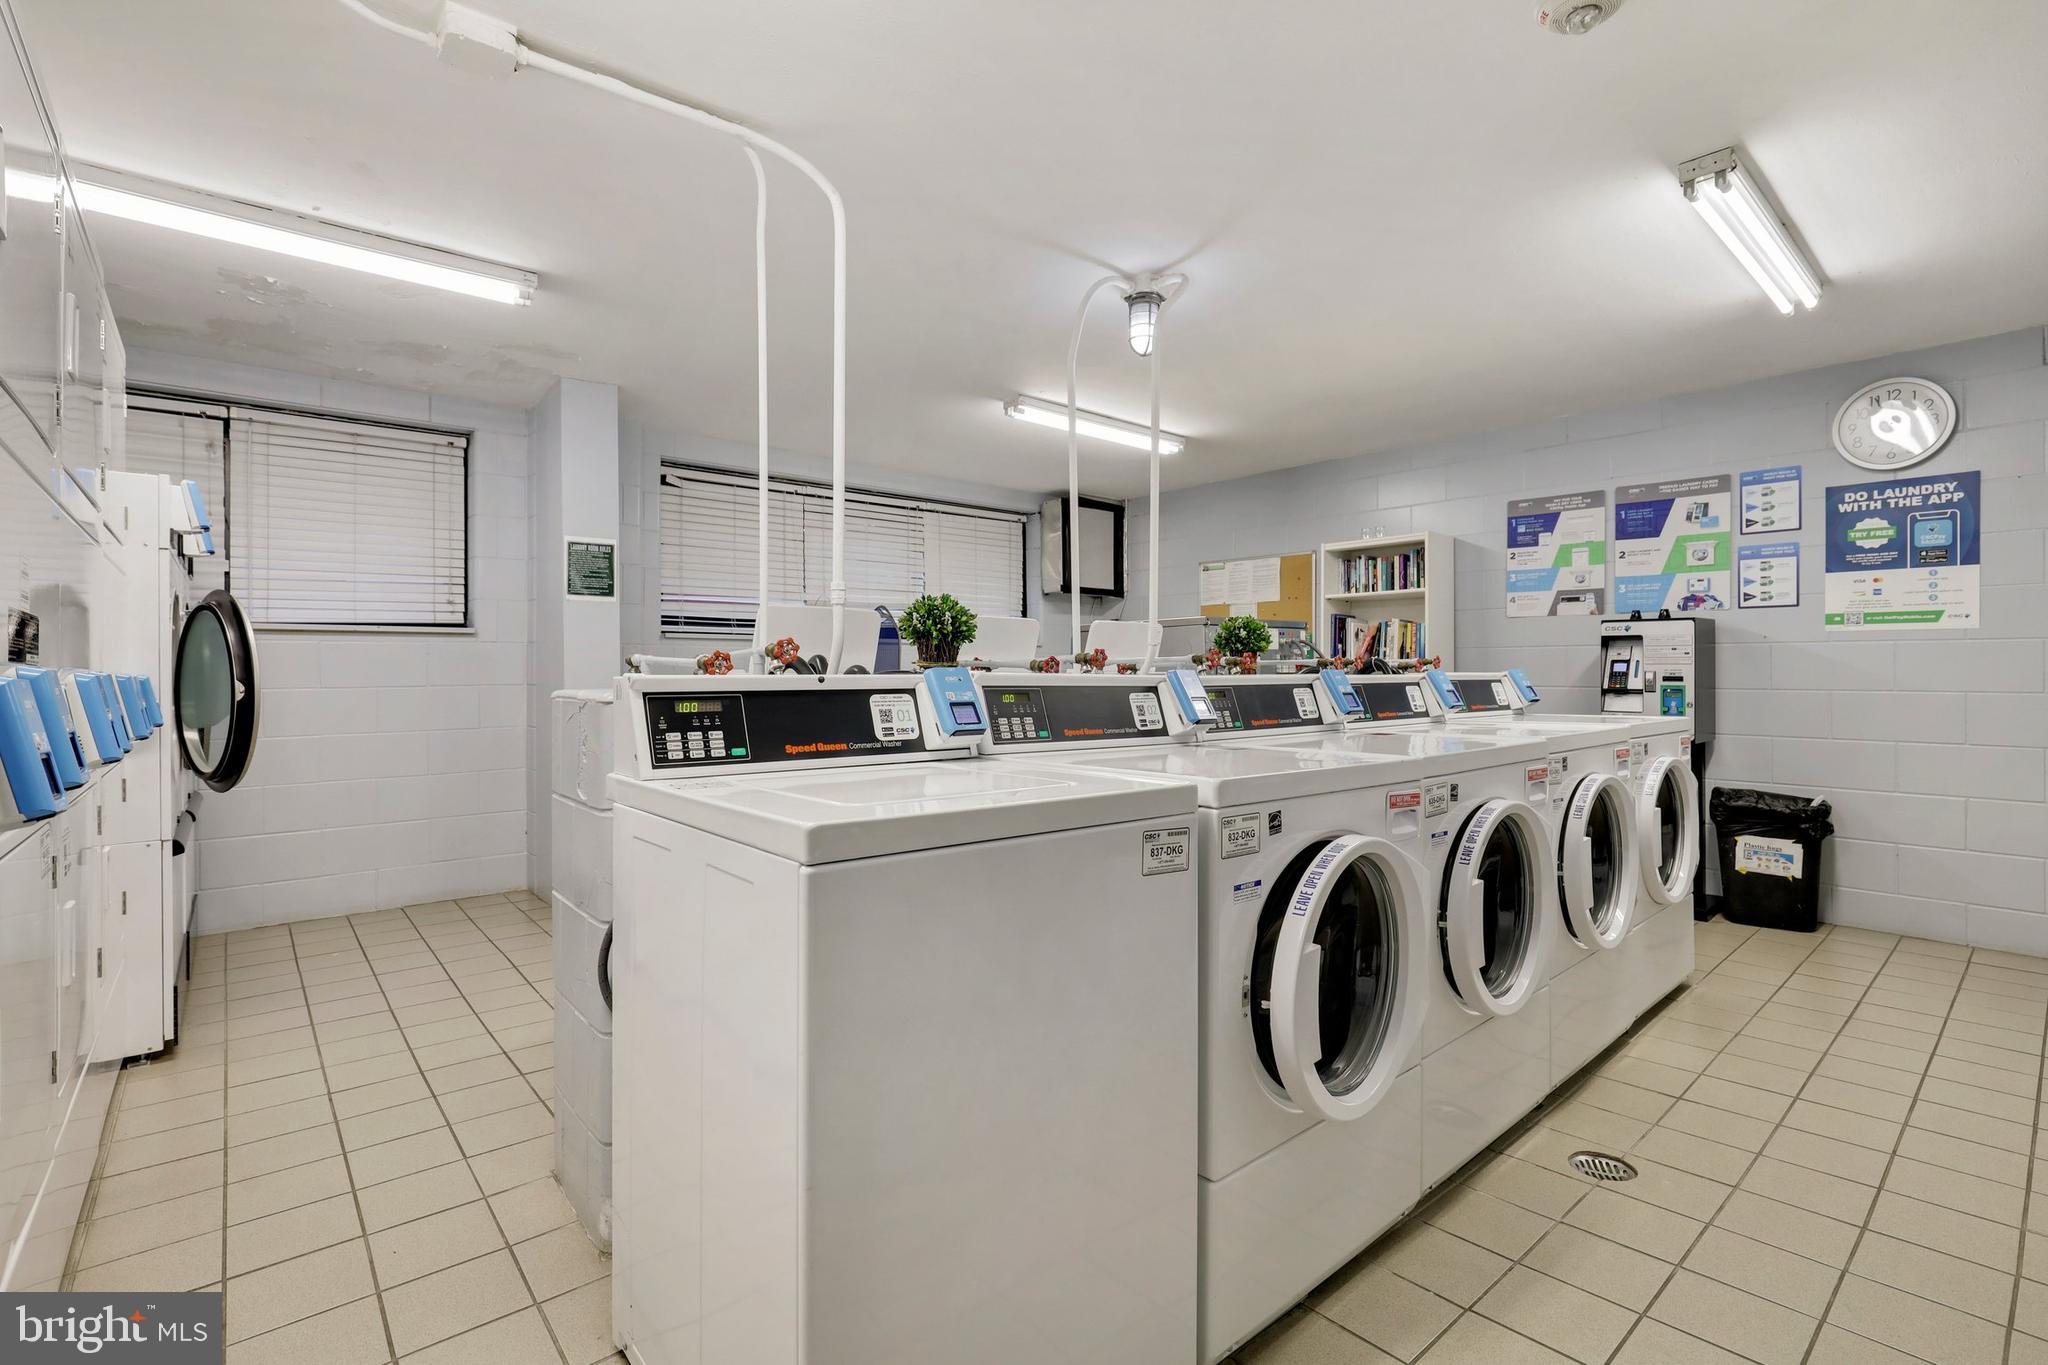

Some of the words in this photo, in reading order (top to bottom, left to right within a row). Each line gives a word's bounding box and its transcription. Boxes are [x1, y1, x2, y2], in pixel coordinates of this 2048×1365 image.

[1886, 389, 1902, 400] 12
[1912, 390, 1917, 400] 1
[1924, 399, 1934, 410] 2
[1853, 437, 1863, 448] 8
[1868, 446, 1877, 457] 7
[1886, 448, 1896, 459] 6
[1844, 491, 1868, 503] DO
[1873, 481, 1959, 499] LAUNDRY
[1838, 501, 1882, 513] WITH
[1887, 496, 1923, 509] THE
[1928, 492, 1965, 504] APP
[1620, 511, 1625, 519] 1
[1511, 519, 1516, 527] 1
[1871, 529, 1895, 537] FREE
[1619, 551, 1626, 559] 2
[1510, 574, 1516, 582] 3
[1619, 584, 1626, 593] 3
[897, 709, 912, 721] 01
[1064, 728, 1084, 737] Speed
[785, 744, 817, 754] Speed
[817, 742, 848, 751] Queen
[849, 740, 881, 749] Commercial
[1228, 829, 1256, 842] 832-DKG
[1466, 830, 1481, 843] OPEN
[1150, 844, 1184, 858] 837-DKG
[1458, 845, 1475, 865] LEAVE
[1292, 890, 1314, 917] LEAVE
[1303, 870, 1324, 890] OPEN
[1314, 853, 1337, 870] WHEN
